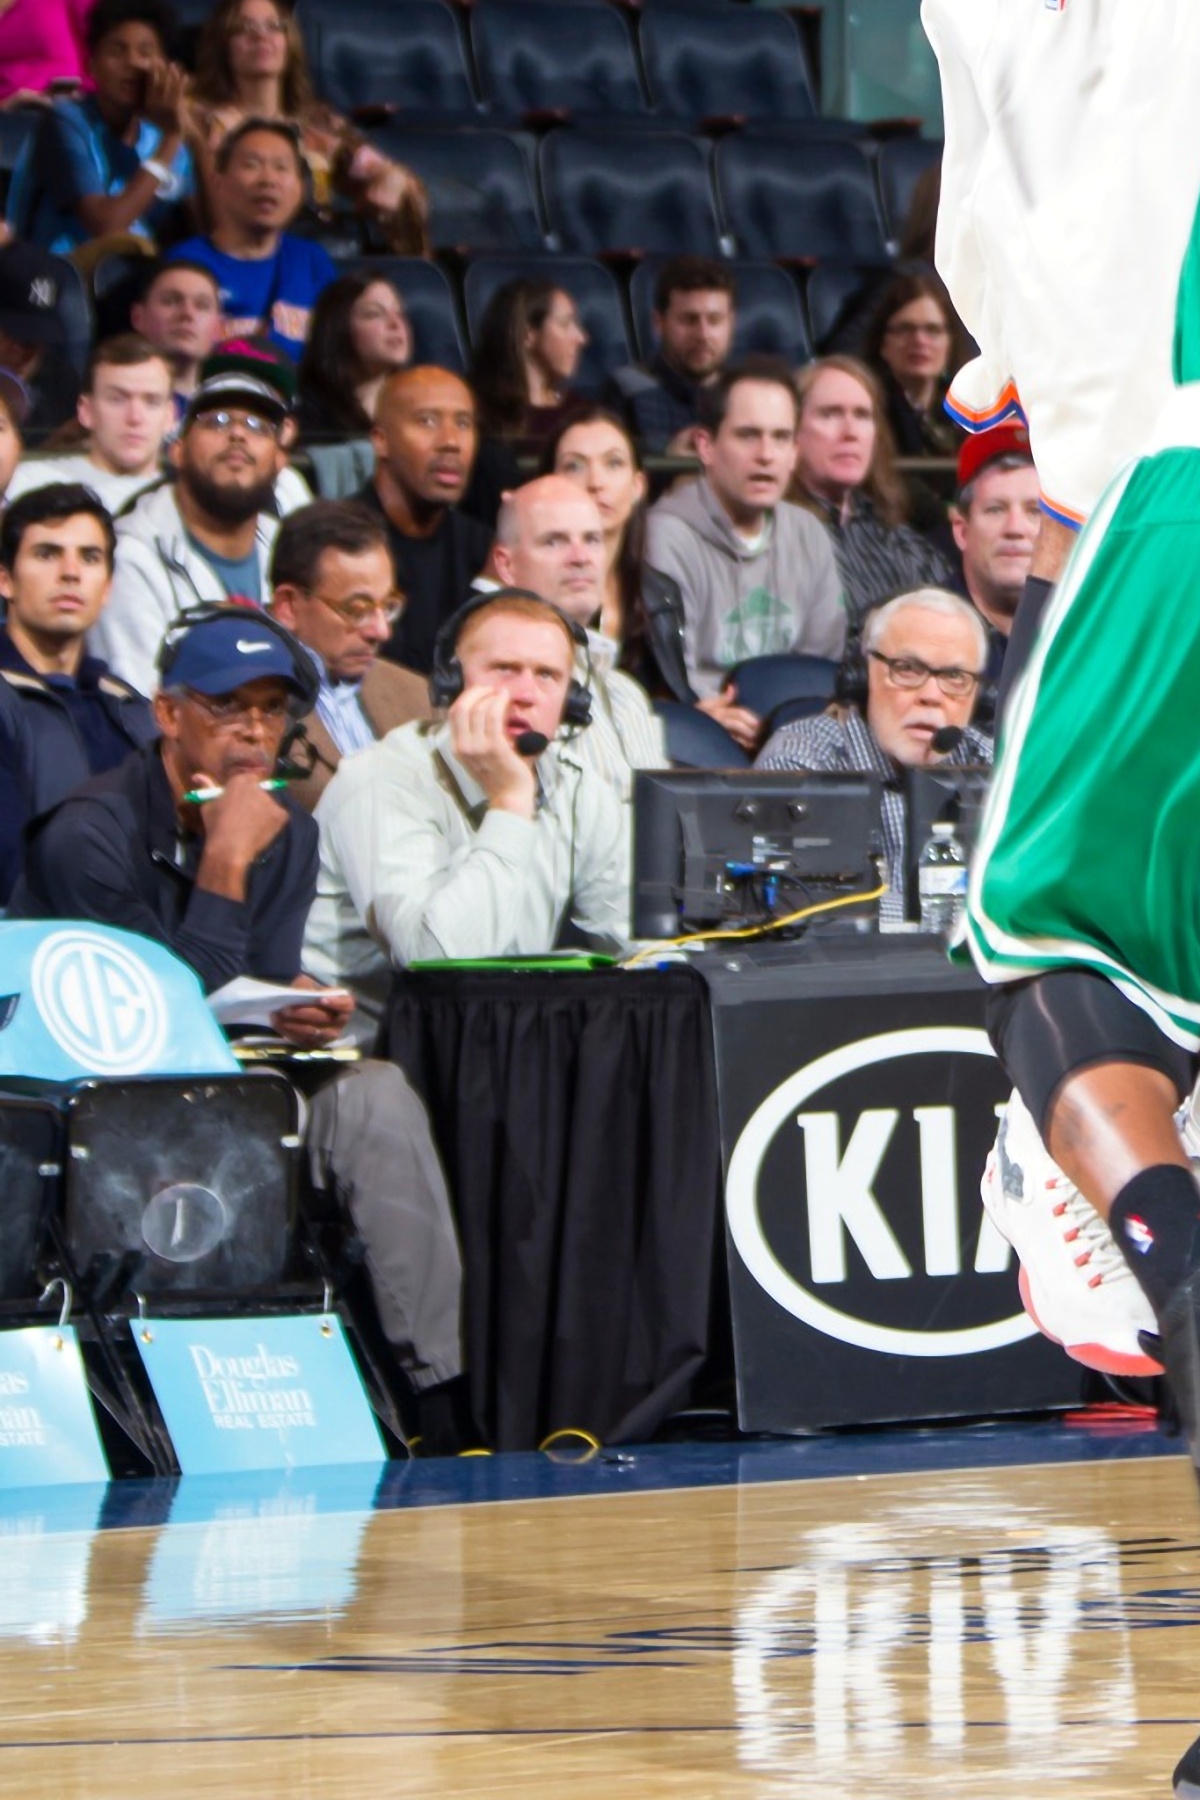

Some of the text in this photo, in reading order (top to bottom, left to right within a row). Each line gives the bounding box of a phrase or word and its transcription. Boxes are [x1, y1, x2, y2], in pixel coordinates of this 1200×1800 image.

[189, 1343, 299, 1390] Douglas
[201, 1378, 312, 1413] Elliman
[213, 1412, 317, 1429] REAL ESTATE
